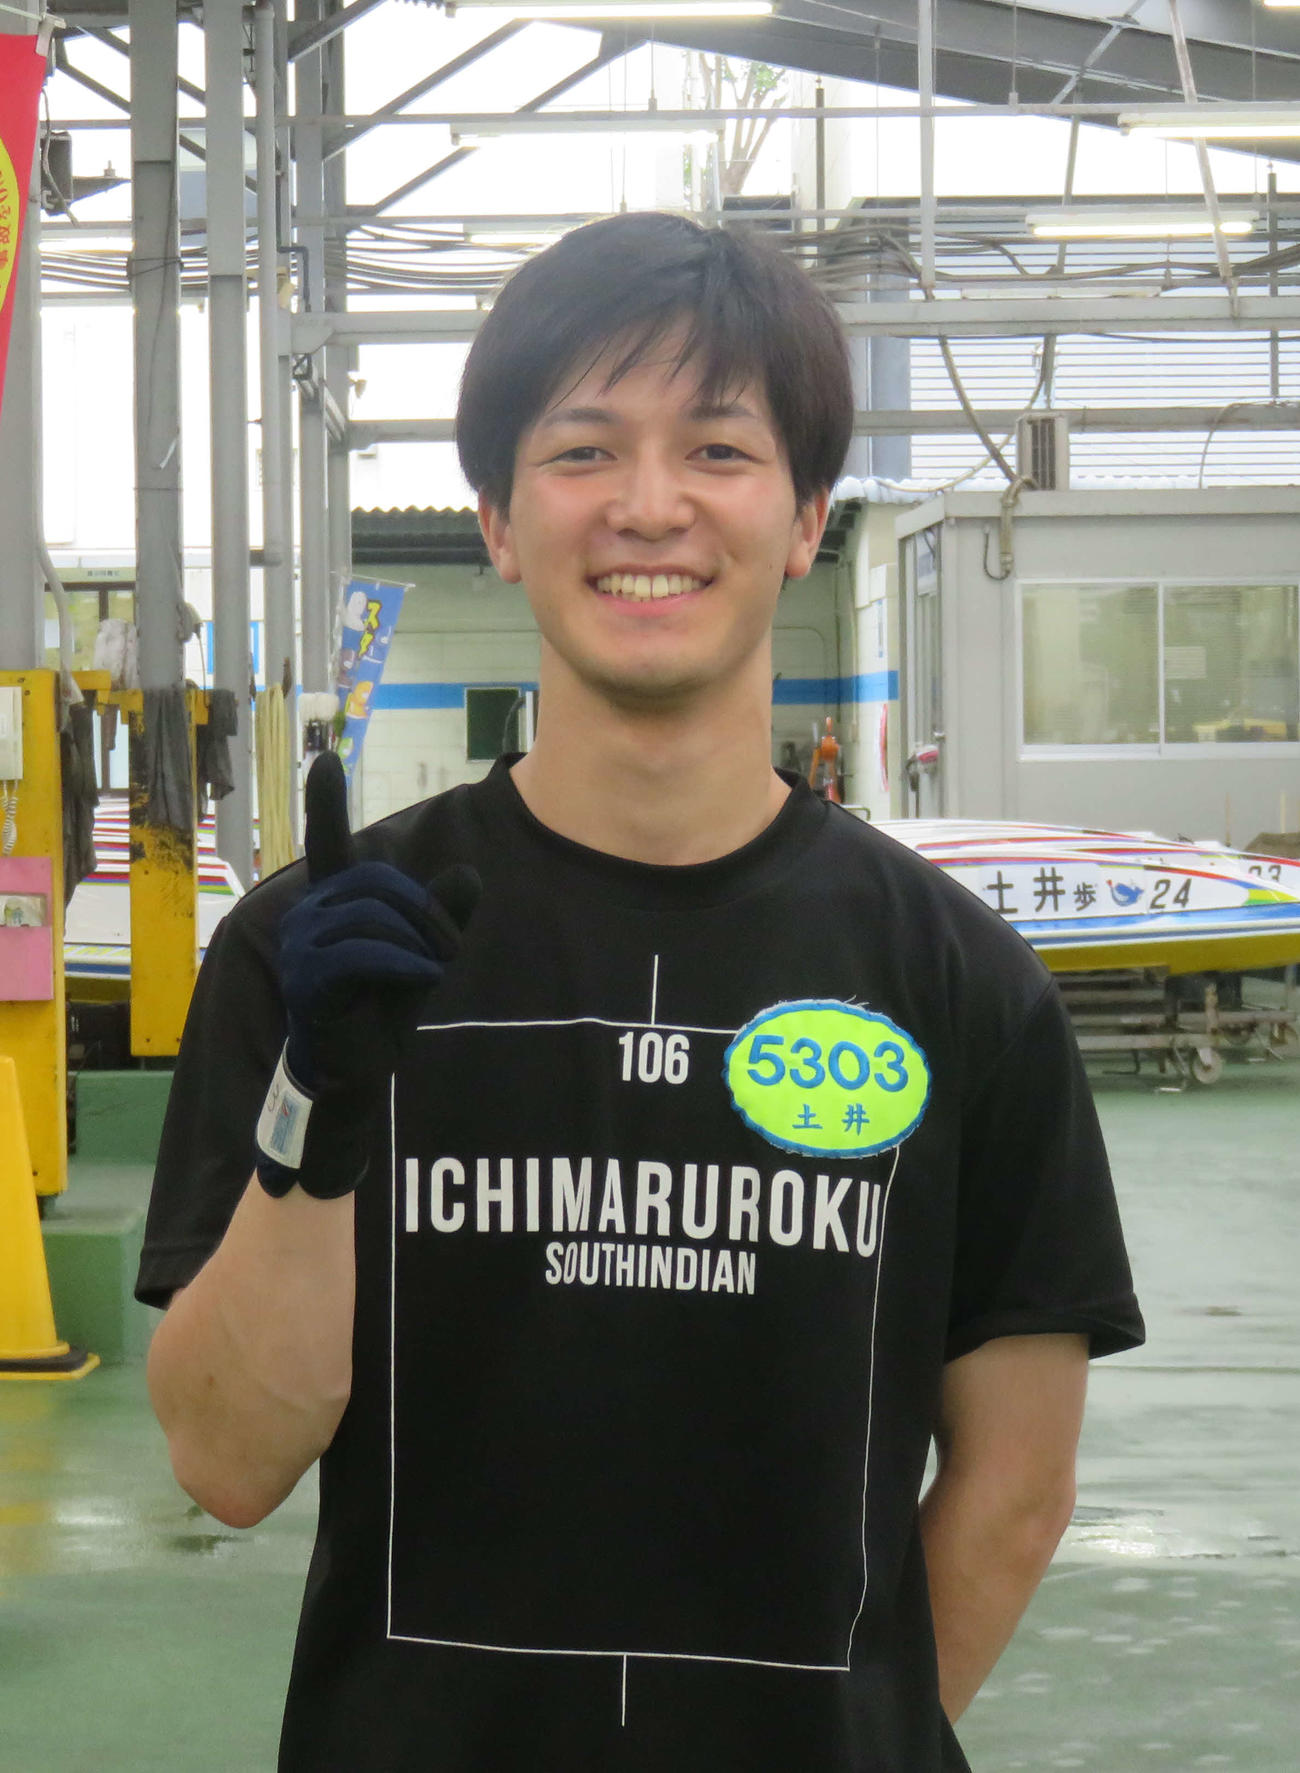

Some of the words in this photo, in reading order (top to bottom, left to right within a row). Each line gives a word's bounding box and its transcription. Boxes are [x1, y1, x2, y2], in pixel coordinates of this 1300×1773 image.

[1150, 879, 1192, 910] 24
[618, 1031, 690, 1085] 106
[746, 1034, 909, 1092] 5303
[792, 1103, 871, 1136] 土井
[405, 1157, 881, 1258] ICHIMARUROKU
[545, 1241, 756, 1295] SOUTHINDIAN
